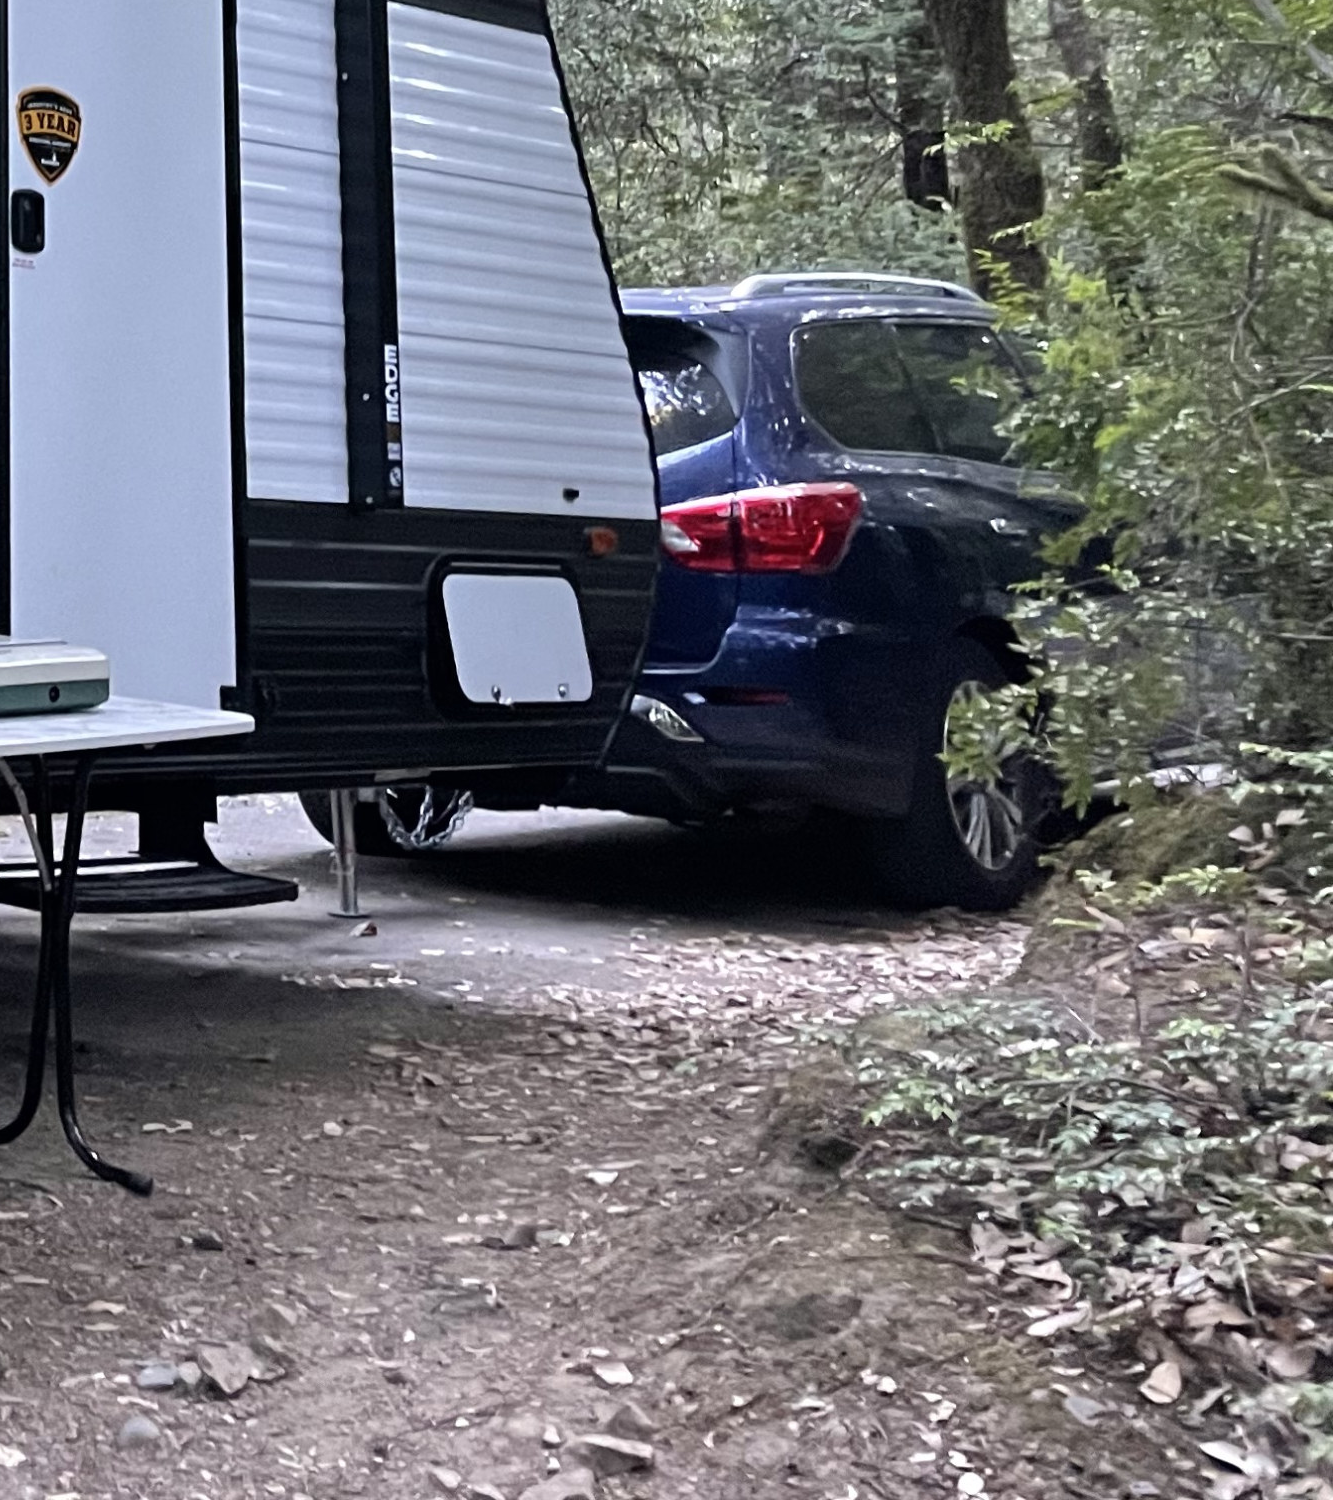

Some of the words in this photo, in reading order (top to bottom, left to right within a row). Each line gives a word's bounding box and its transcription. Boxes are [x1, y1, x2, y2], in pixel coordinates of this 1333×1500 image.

[24, 113, 33, 131] 3
[36, 112, 76, 138] YEAR
[384, 344, 400, 423] EDGE
